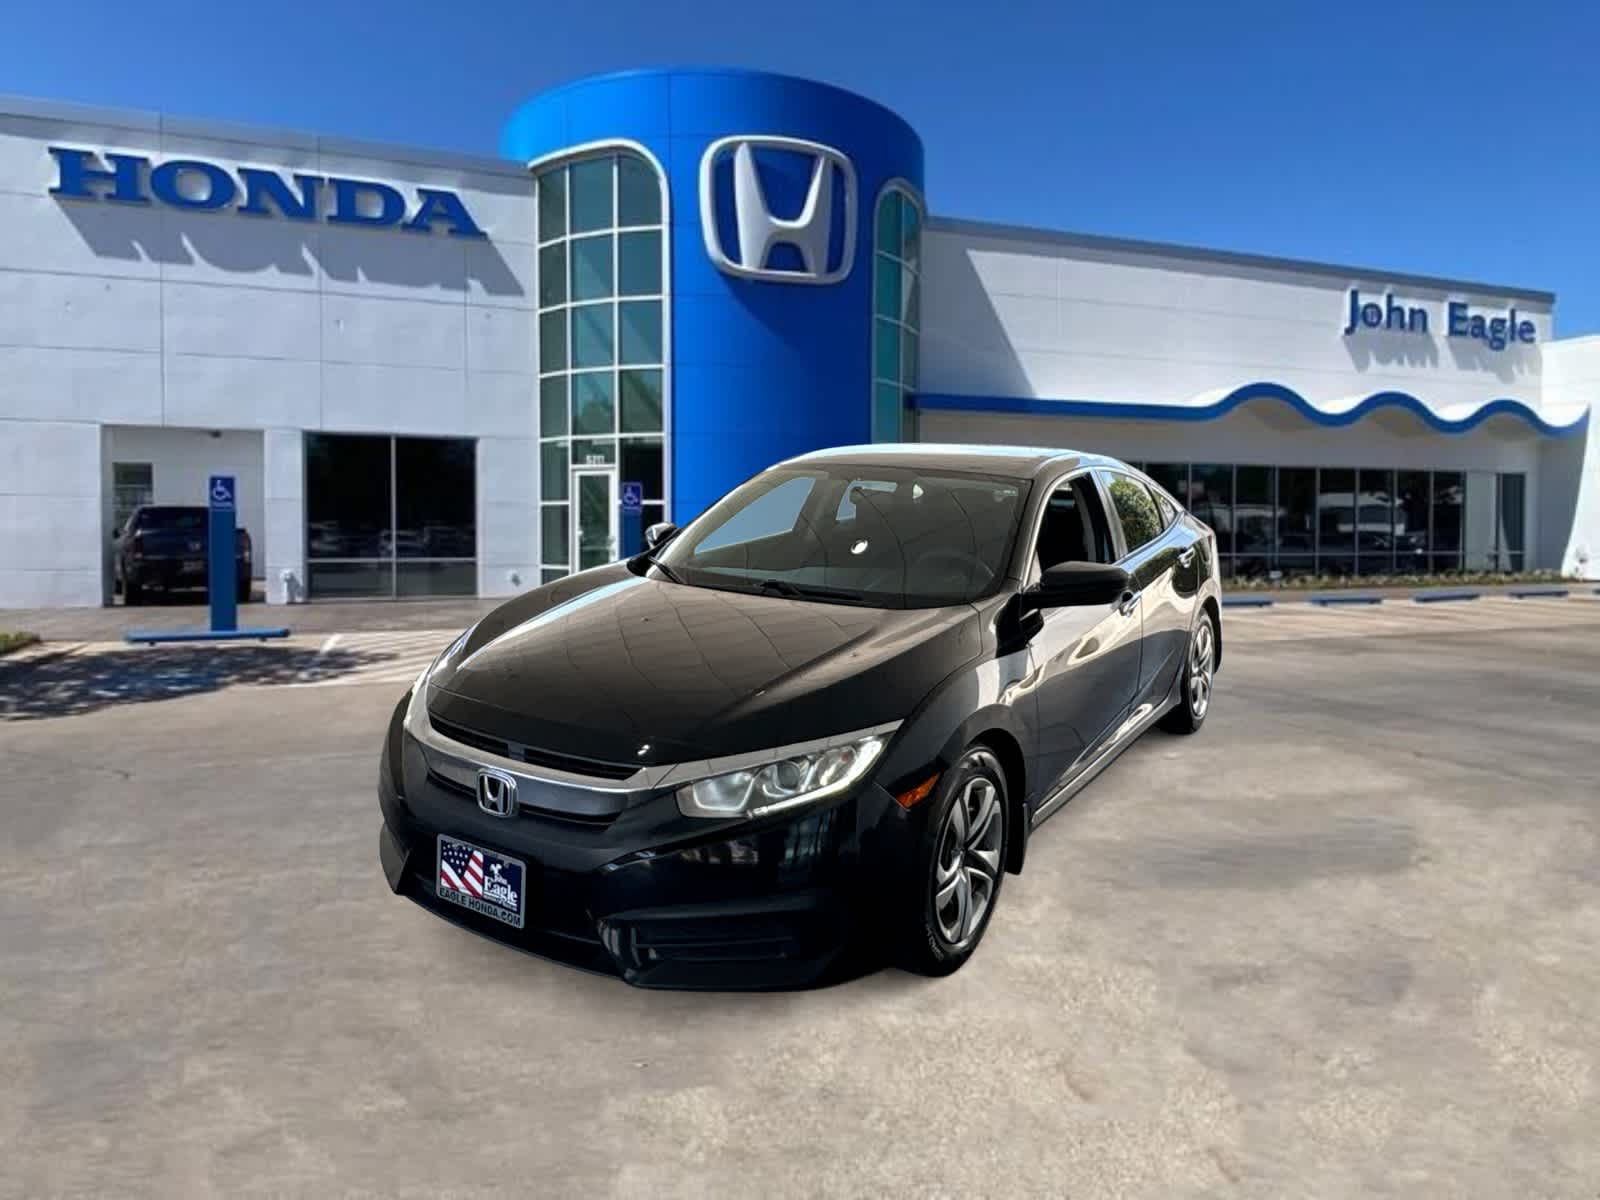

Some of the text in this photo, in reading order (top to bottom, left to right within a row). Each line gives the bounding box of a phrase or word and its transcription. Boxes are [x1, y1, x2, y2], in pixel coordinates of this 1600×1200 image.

[48, 146, 488, 238] HONDA
[1344, 288, 1536, 351] John Eagle
[440, 887, 466, 906] EAGLE
[484, 875, 518, 903] Eagle
